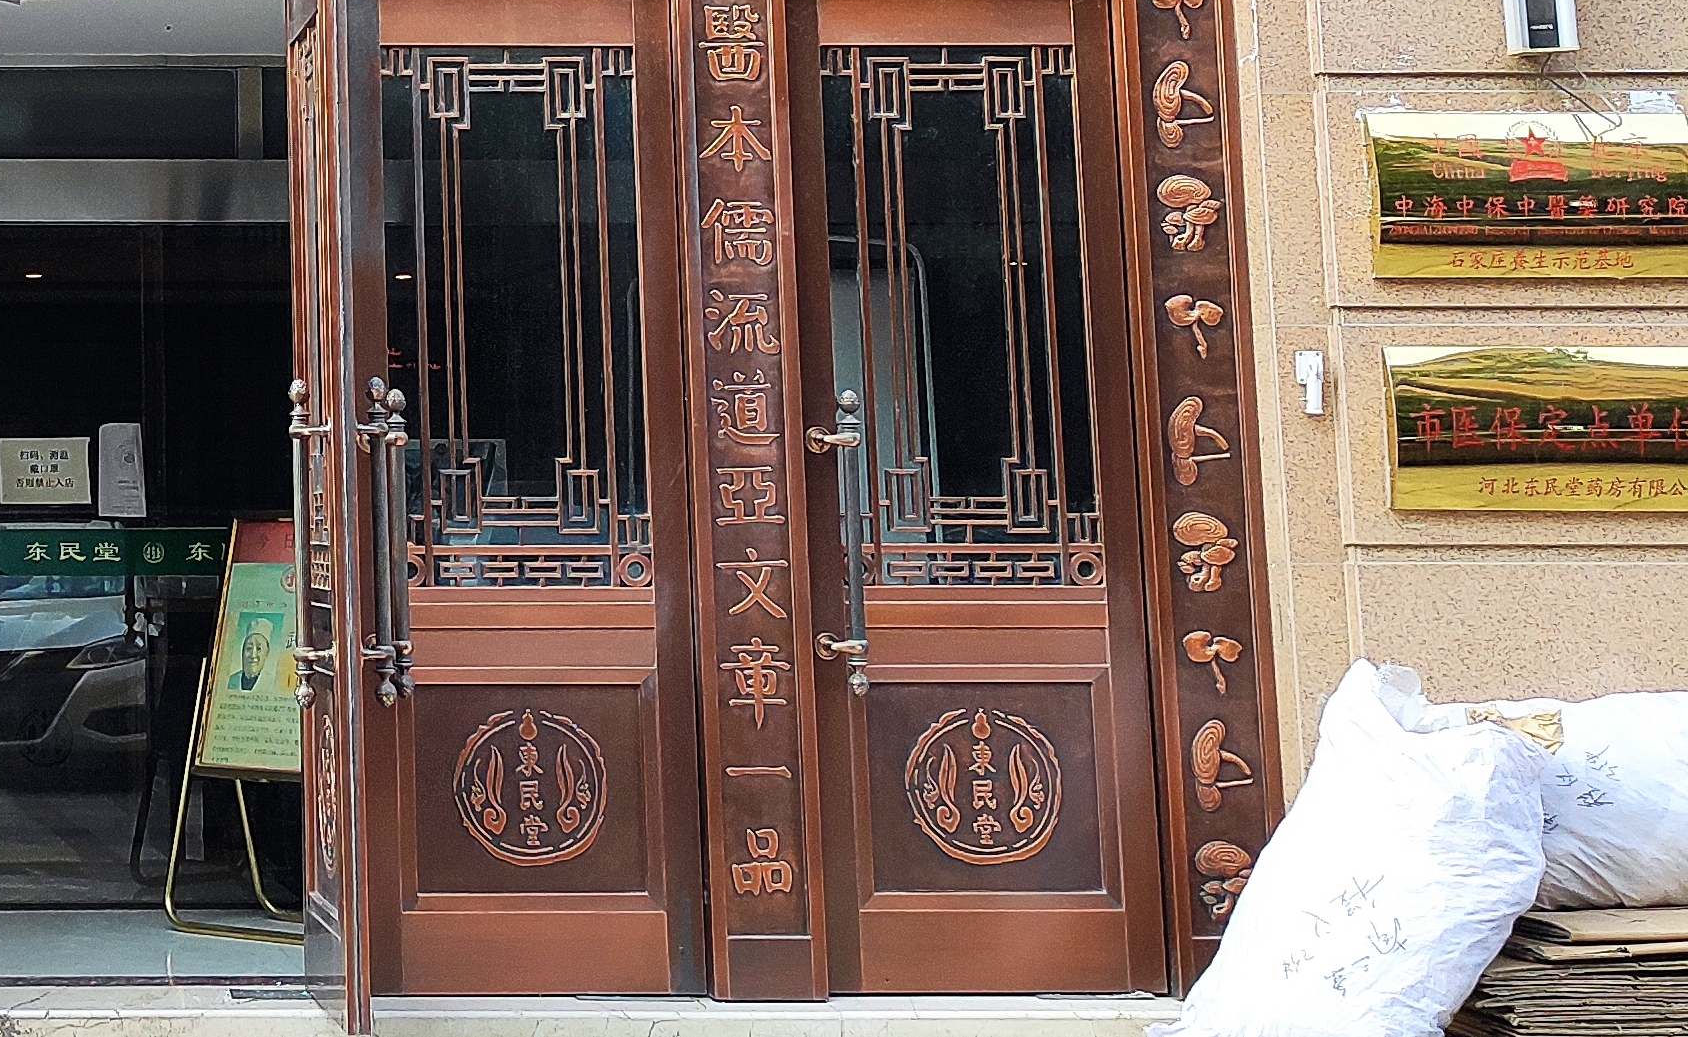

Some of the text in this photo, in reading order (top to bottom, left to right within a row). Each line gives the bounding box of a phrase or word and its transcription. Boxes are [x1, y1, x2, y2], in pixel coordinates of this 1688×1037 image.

[23, 541, 122, 562] 东民堂
[185, 541, 226, 562] 东
[516, 742, 549, 846] 東民堂
[968, 741, 1002, 845] 東民堂
